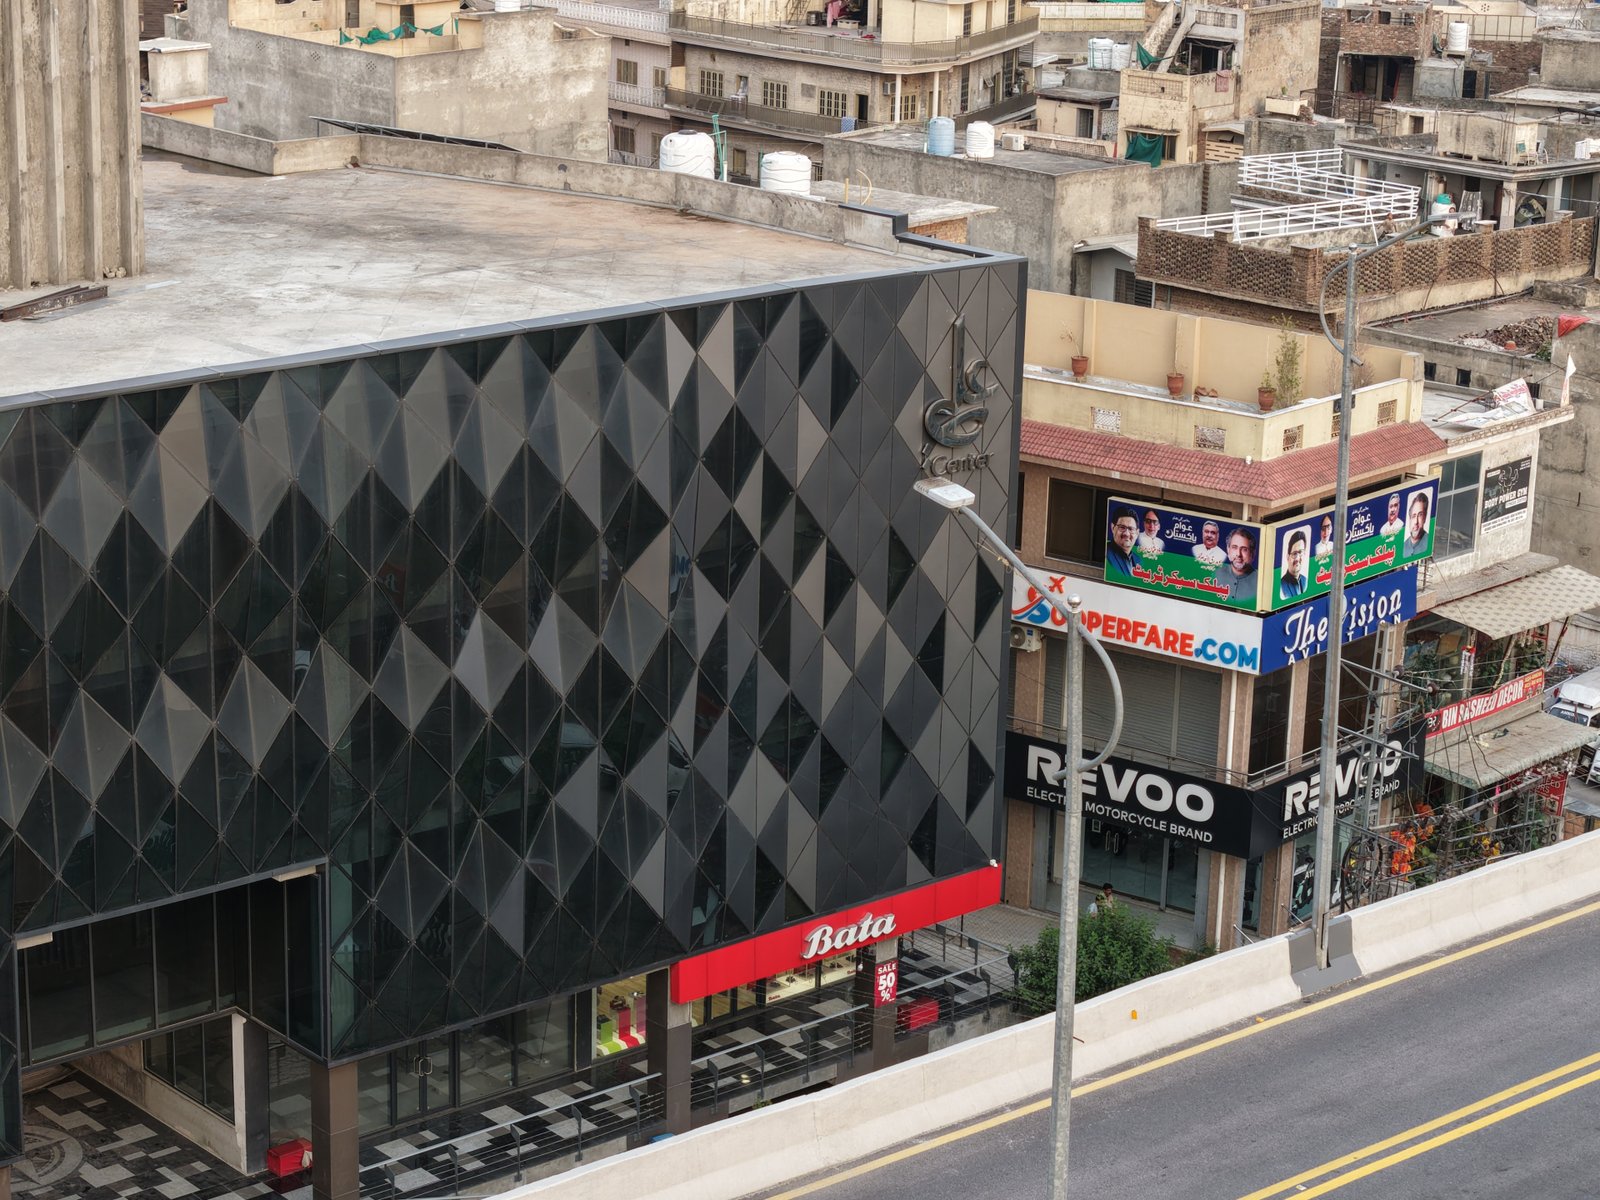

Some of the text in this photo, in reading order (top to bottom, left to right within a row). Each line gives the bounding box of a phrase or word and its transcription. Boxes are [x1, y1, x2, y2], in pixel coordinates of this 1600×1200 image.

[1499, 491, 1516, 504] POWER
[1284, 606, 1328, 653] The
[1288, 614, 1401, 666] AVITIN
[1441, 706, 1459, 729] BIN
[1497, 680, 1525, 708] DECOR
[1085, 801, 1167, 832] MOTORCYCLE
[1169, 823, 1213, 844] BRAND
[802, 912, 897, 959] Bata
[877, 963, 897, 974] SALE
[877, 972, 896, 991] 50
